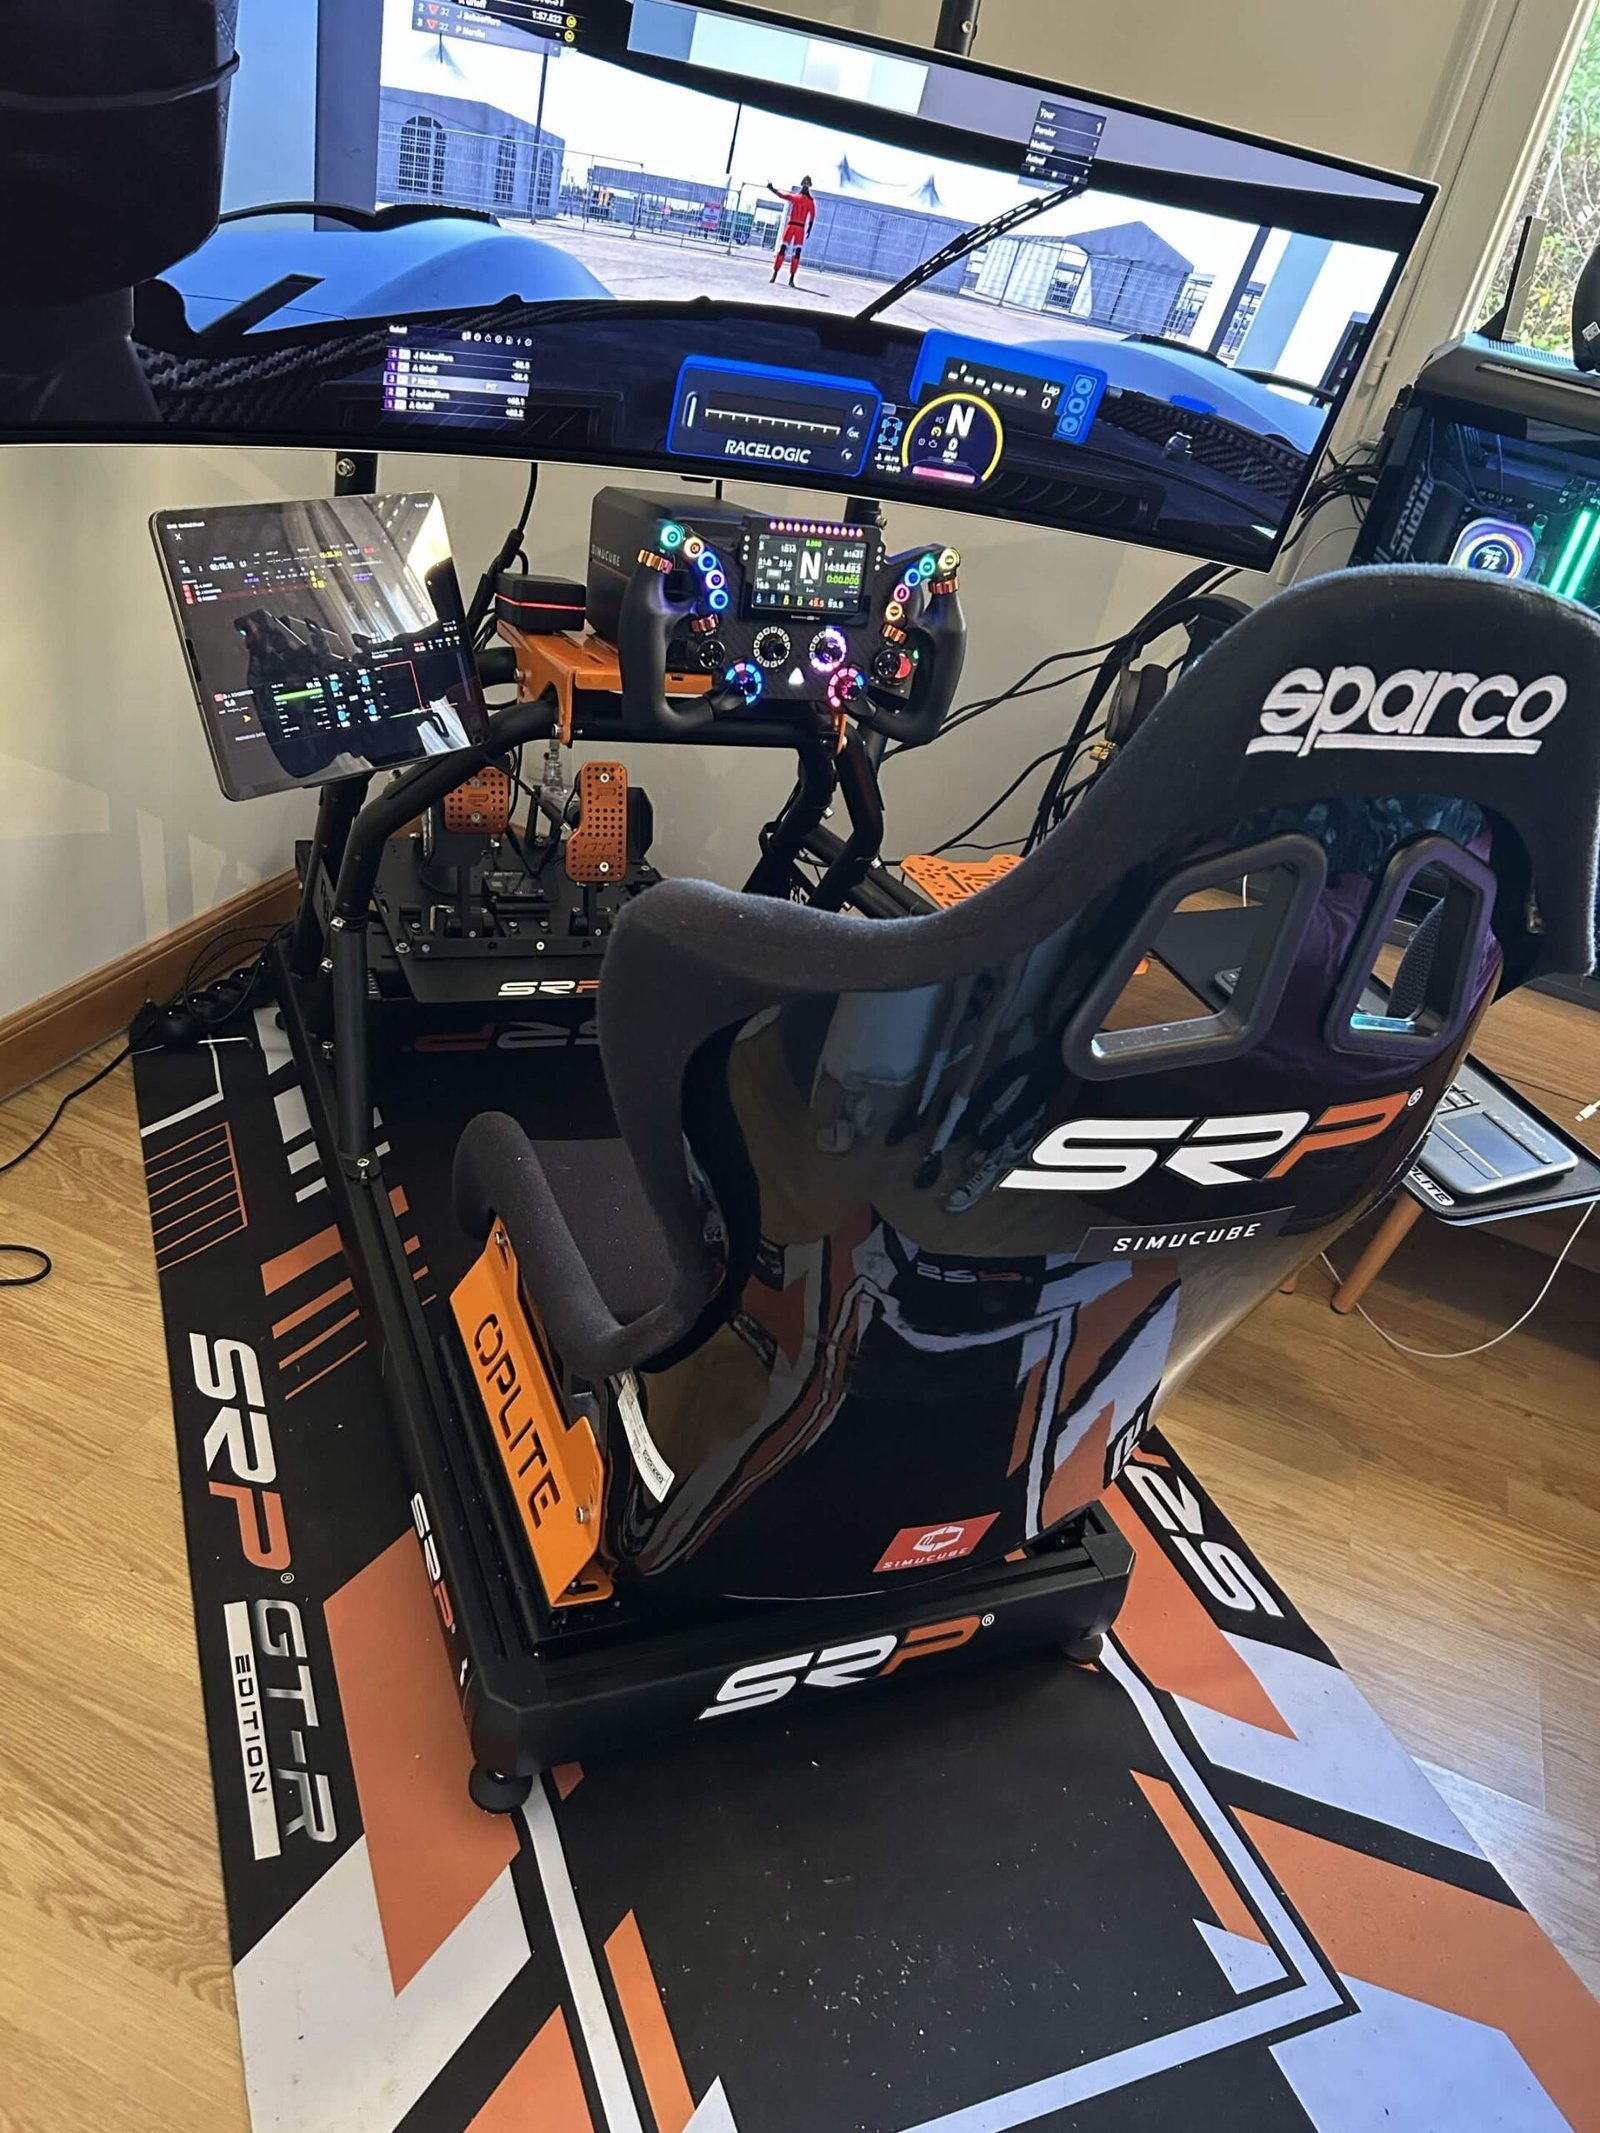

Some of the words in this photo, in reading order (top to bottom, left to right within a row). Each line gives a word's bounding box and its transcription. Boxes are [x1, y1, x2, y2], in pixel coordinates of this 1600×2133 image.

[1041, 397, 1051, 410] 0
[1042, 382, 1060, 396] Lap
[946, 403, 975, 437] N
[724, 439, 812, 464] RACELOGIC
[948, 437, 958, 451] 0
[800, 550, 821, 580] N
[1260, 666, 1567, 757] sparco
[1113, 1222, 1260, 1252] SIMUCUBE
[474, 1313, 561, 1529] OPLITE
[882, 1546, 969, 1569] SIMUCUBE
[234, 1654, 267, 1794] EDITION
[255, 1599, 337, 1843] GT-R
